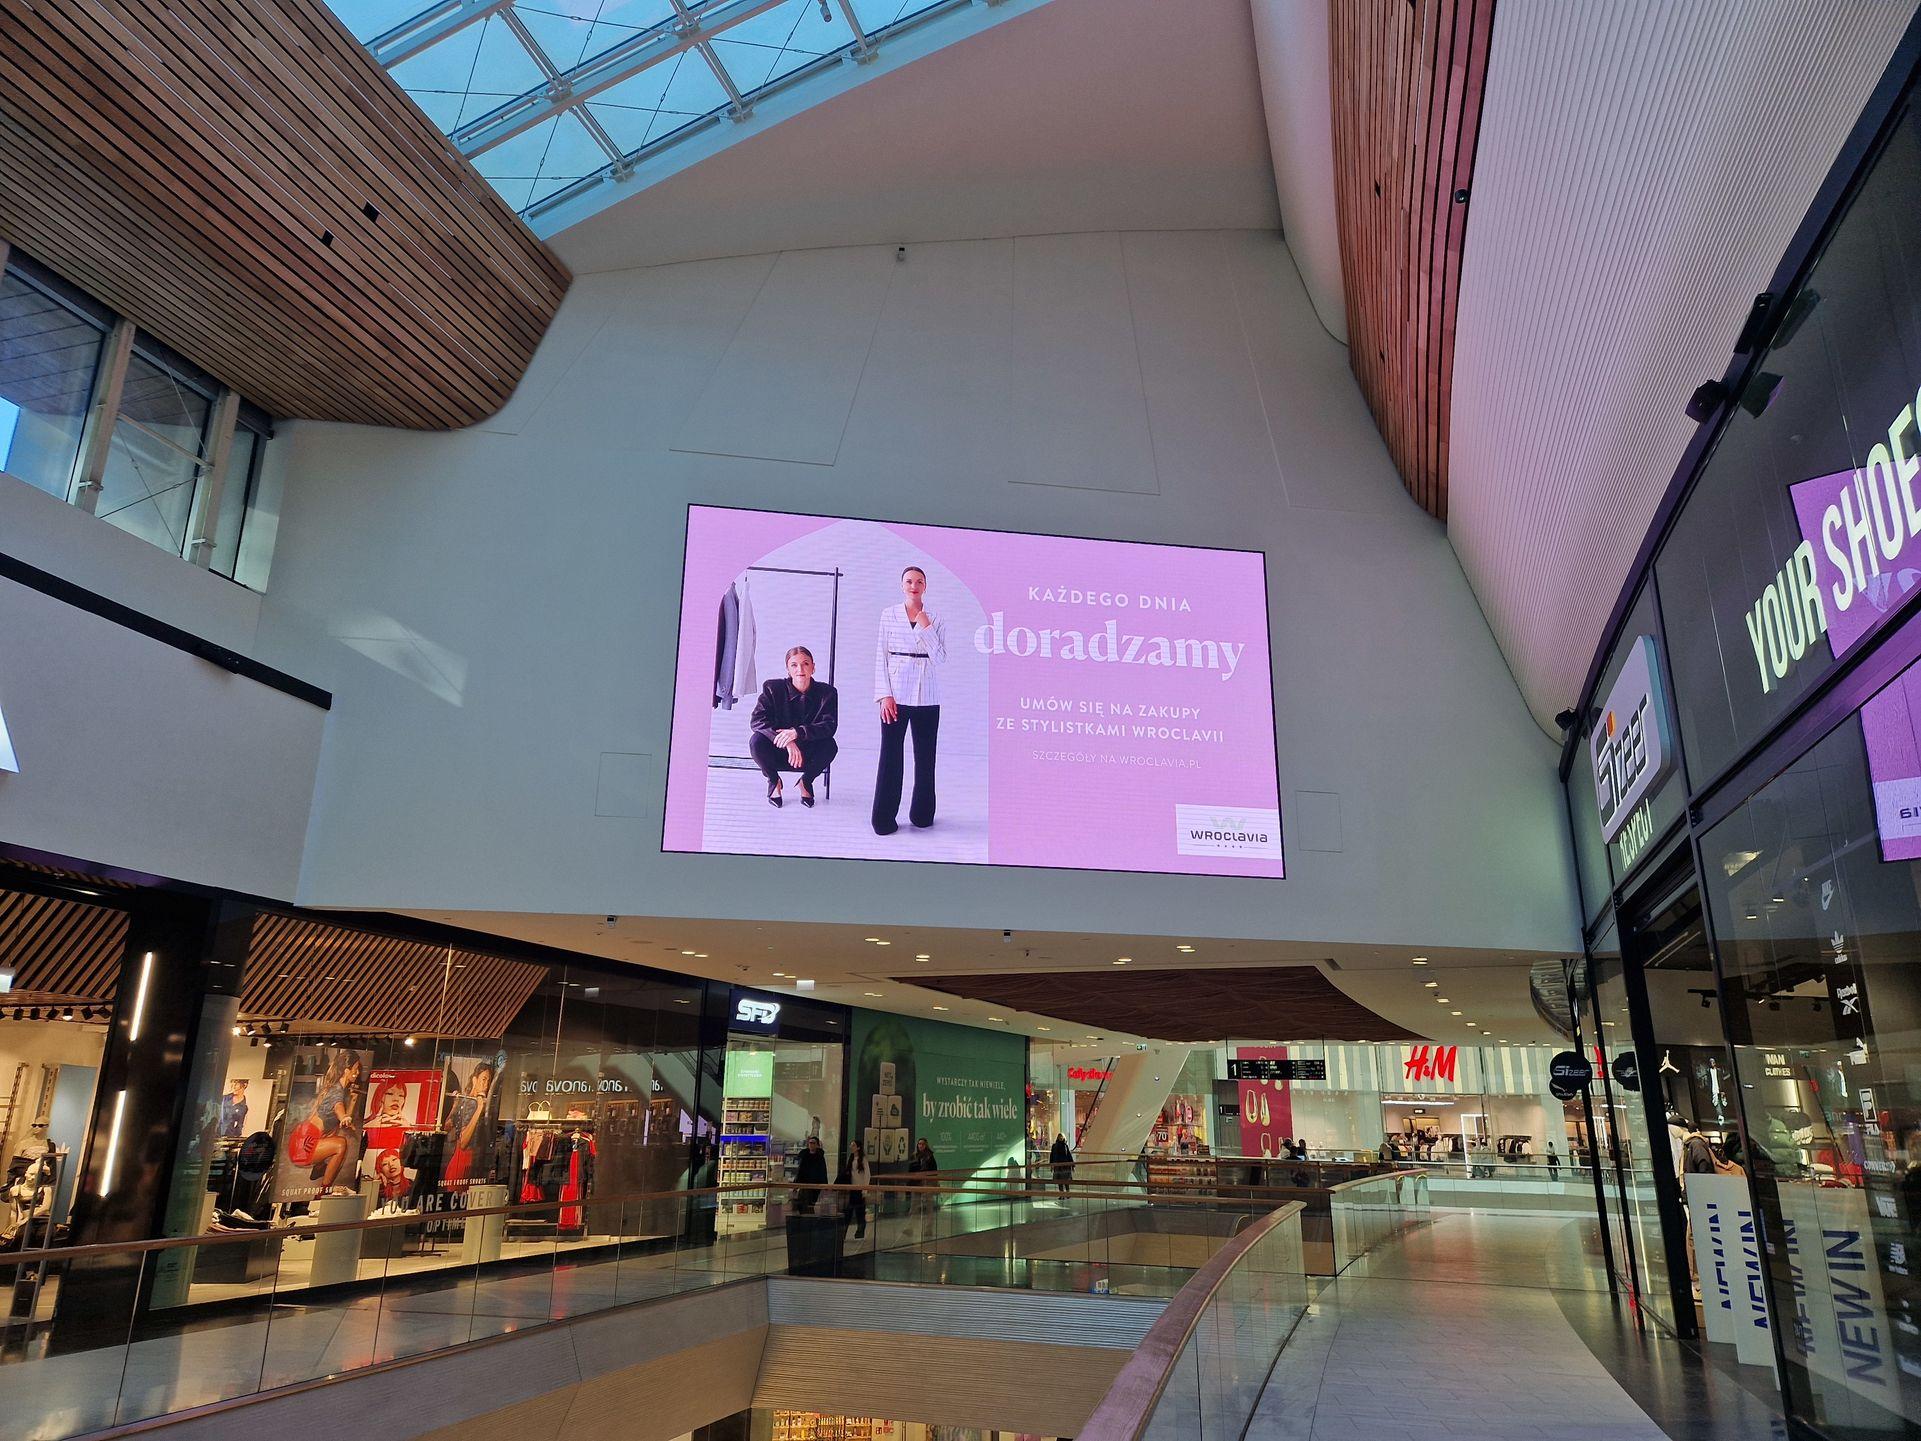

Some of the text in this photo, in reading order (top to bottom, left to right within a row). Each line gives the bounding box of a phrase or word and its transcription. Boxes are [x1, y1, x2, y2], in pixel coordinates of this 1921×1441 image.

[1745, 384, 1921, 694] YOUR SHOE
[1028, 585, 1191, 612] KAŻDEGO DNIA
[973, 611, 1246, 681] doradzamy
[1020, 696, 1201, 720] UMÓW SIĘ NA ZAKUPY
[996, 717, 1224, 743] ZE STYLISTKAMI WROCLAVII
[1100, 754, 1116, 764] NA
[736, 999, 780, 1024] SFD
[1231, 1063, 1237, 1077] 1
[1404, 1045, 1457, 1082] H&M
[1553, 1065, 1590, 1077] Sizeer
[968, 1079, 978, 1089] TAK
[922, 1092, 1018, 1123] by zrobić tak wiele
[416, 1193, 444, 1214] ARE
